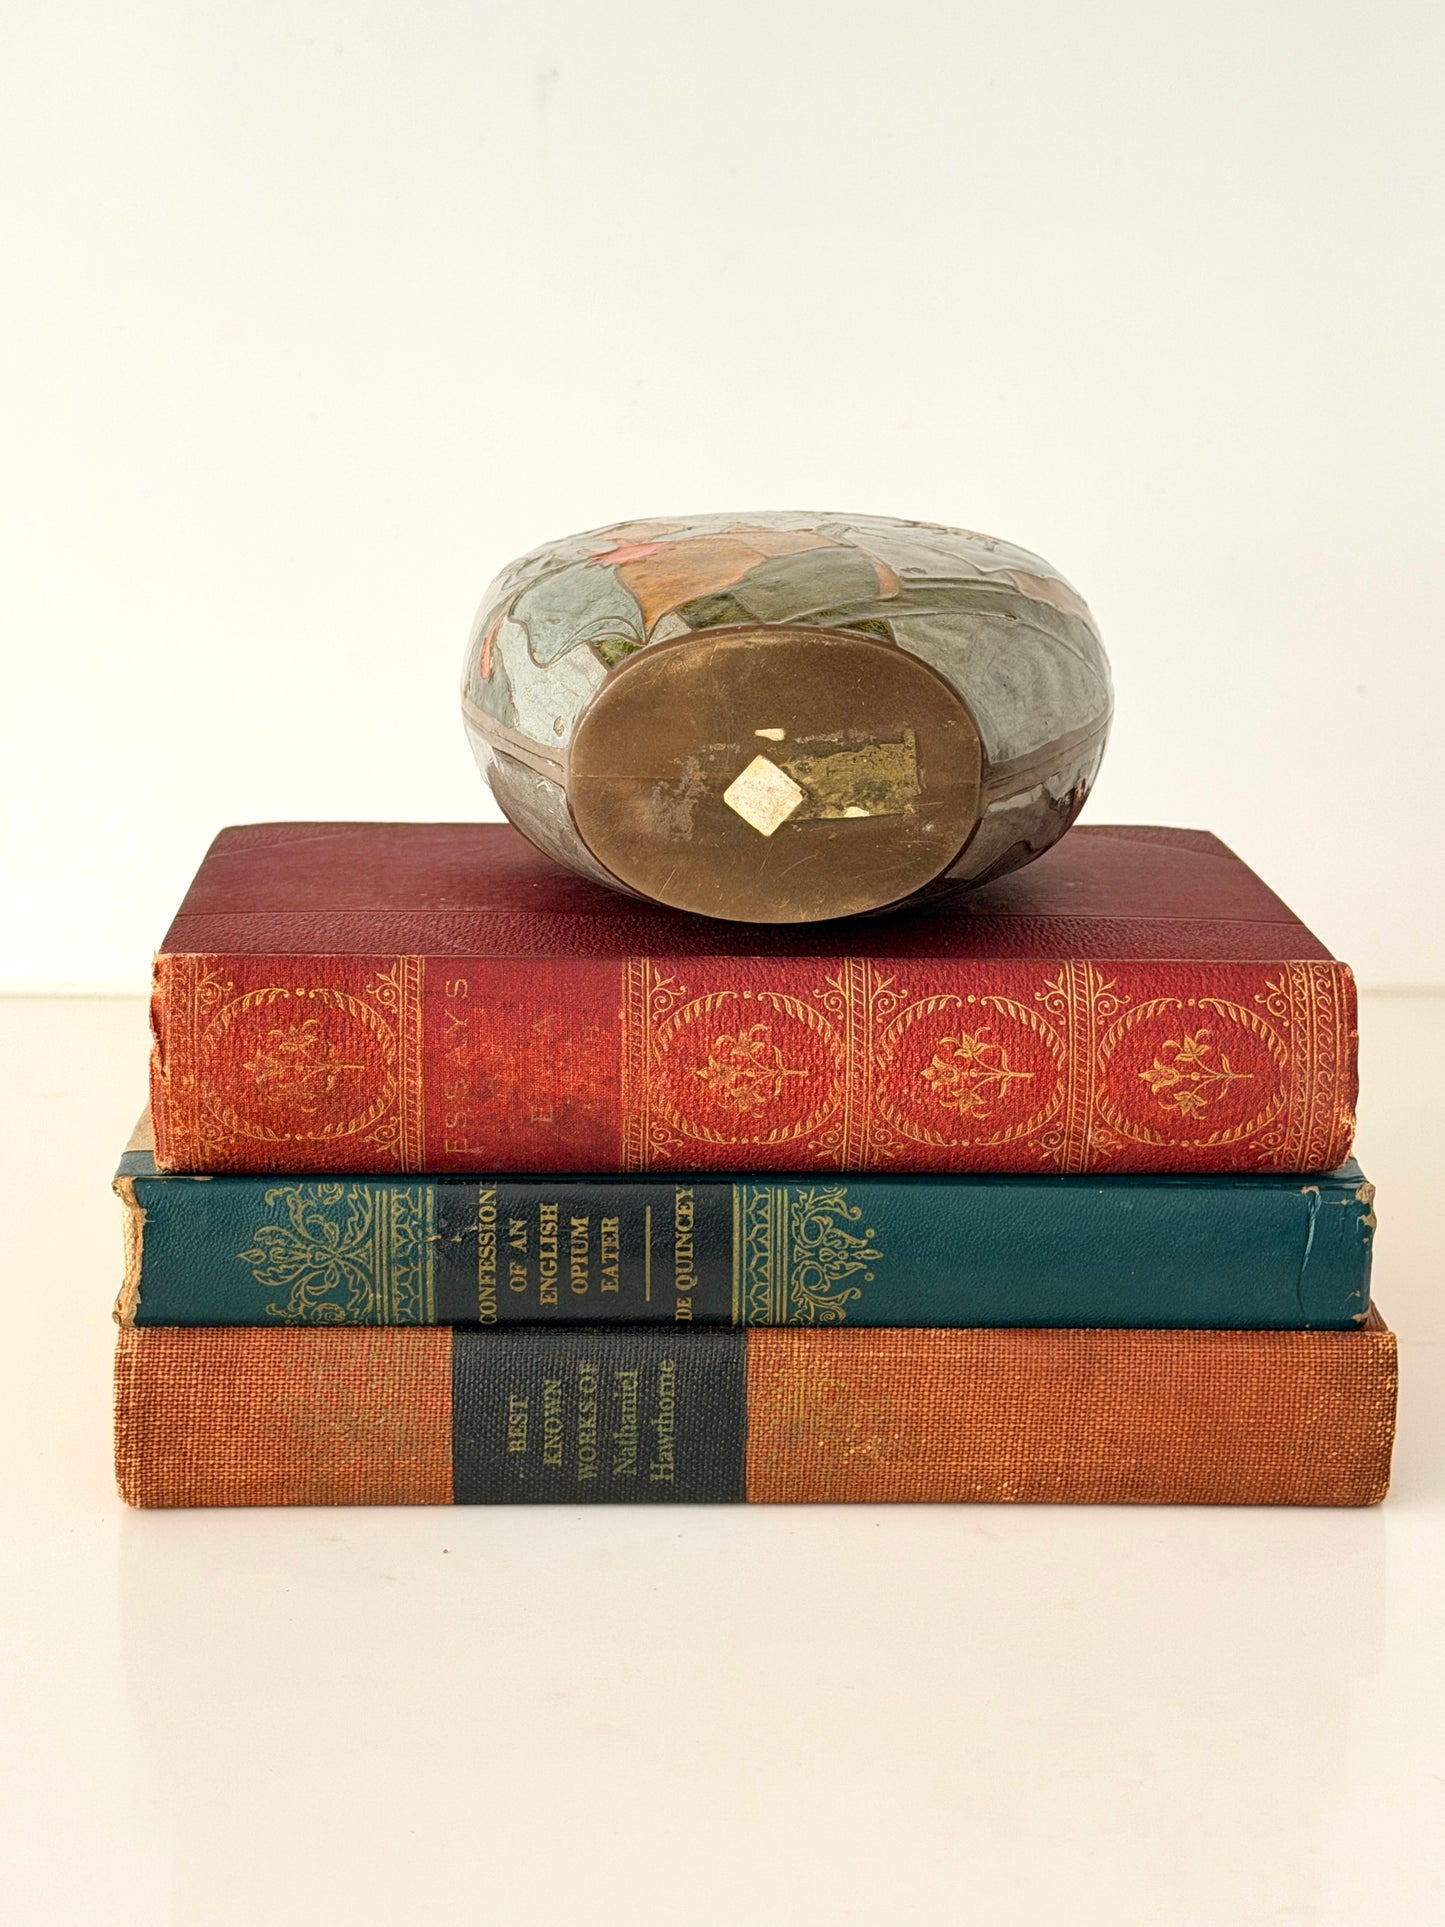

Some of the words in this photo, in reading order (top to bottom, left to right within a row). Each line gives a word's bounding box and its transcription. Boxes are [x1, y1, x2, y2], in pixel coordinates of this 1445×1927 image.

[445, 978, 468, 1154] ESSAYS
[531, 1012, 556, 1123] EA
[509, 1217, 528, 1252] AN
[539, 1203, 559, 1305] ENGLISH
[570, 1215, 590, 1295] OPIUM
[601, 1215, 620, 1293] EATER
[675, 1184, 698, 1291] QUINCEY
[509, 1261, 527, 1293] OF
[675, 1297, 693, 1322] DE
[578, 1359, 599, 1393] OF
[508, 1395, 528, 1453] BEST
[542, 1379, 563, 1467] KNOWN
[577, 1398, 598, 1482] WORKS
[612, 1370, 639, 1477] Nathaniel
[650, 1358, 676, 1485] Hawthorne
